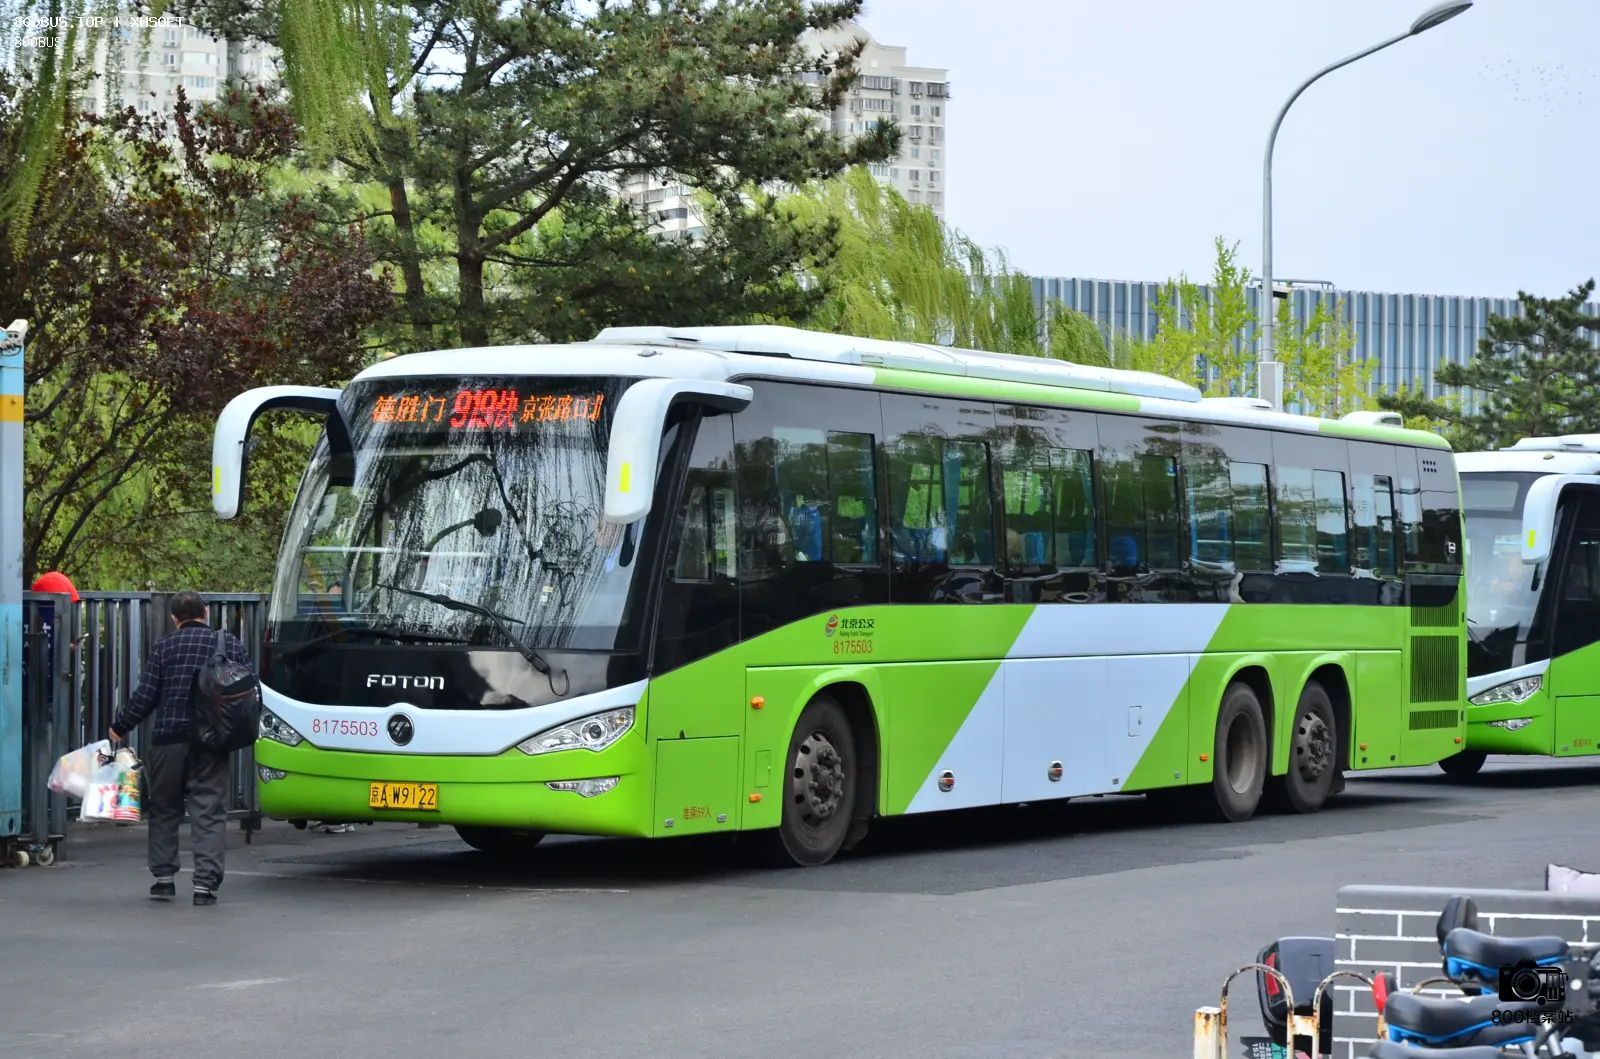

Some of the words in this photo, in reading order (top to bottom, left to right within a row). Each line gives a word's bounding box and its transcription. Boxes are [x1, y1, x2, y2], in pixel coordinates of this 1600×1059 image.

[371, 395, 446, 423] 德胜门
[450, 390, 519, 428] 919快
[840, 618, 875, 629] 北京公交
[833, 640, 873, 655] 8175503
[366, 674, 445, 690] FOTON
[312, 718, 378, 737] 8175503
[682, 804, 711, 820] 准乘59人
